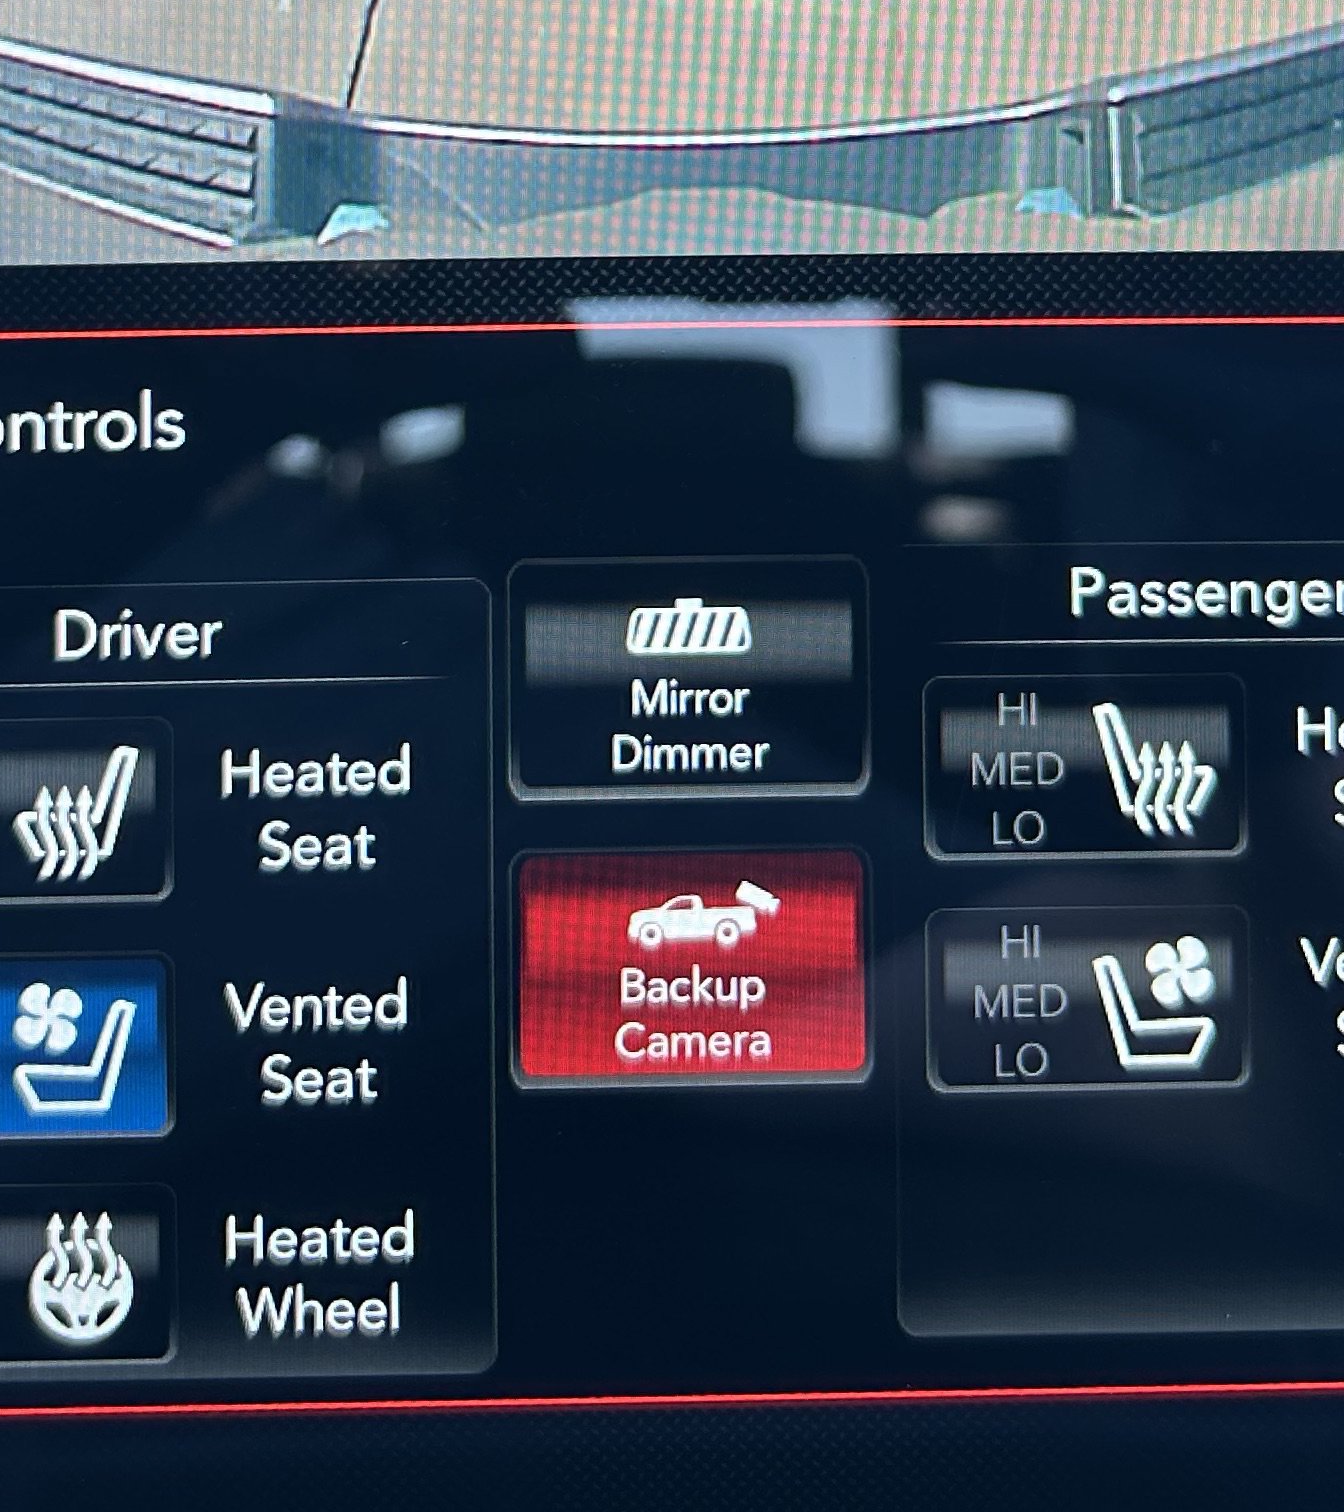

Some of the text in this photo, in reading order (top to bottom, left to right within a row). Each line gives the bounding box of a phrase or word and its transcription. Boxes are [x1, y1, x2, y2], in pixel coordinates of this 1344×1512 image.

[52, 607, 225, 663] Driver
[630, 678, 751, 716] Mirror
[998, 693, 1038, 726] HI
[220, 743, 412, 799] Heated
[611, 734, 770, 772] Dimmer
[971, 752, 1064, 787] MED
[257, 822, 376, 872] Seat
[992, 812, 1045, 844] LO
[1000, 926, 1041, 958] HI
[225, 976, 409, 1030] Vented
[620, 965, 766, 1011] Backup
[974, 984, 1067, 1019] MED
[614, 1021, 772, 1061] Camera
[994, 1045, 1048, 1077] LO
[260, 1057, 378, 1105] Seat
[225, 1210, 415, 1264] Heated
[235, 1283, 401, 1335] Wheel
